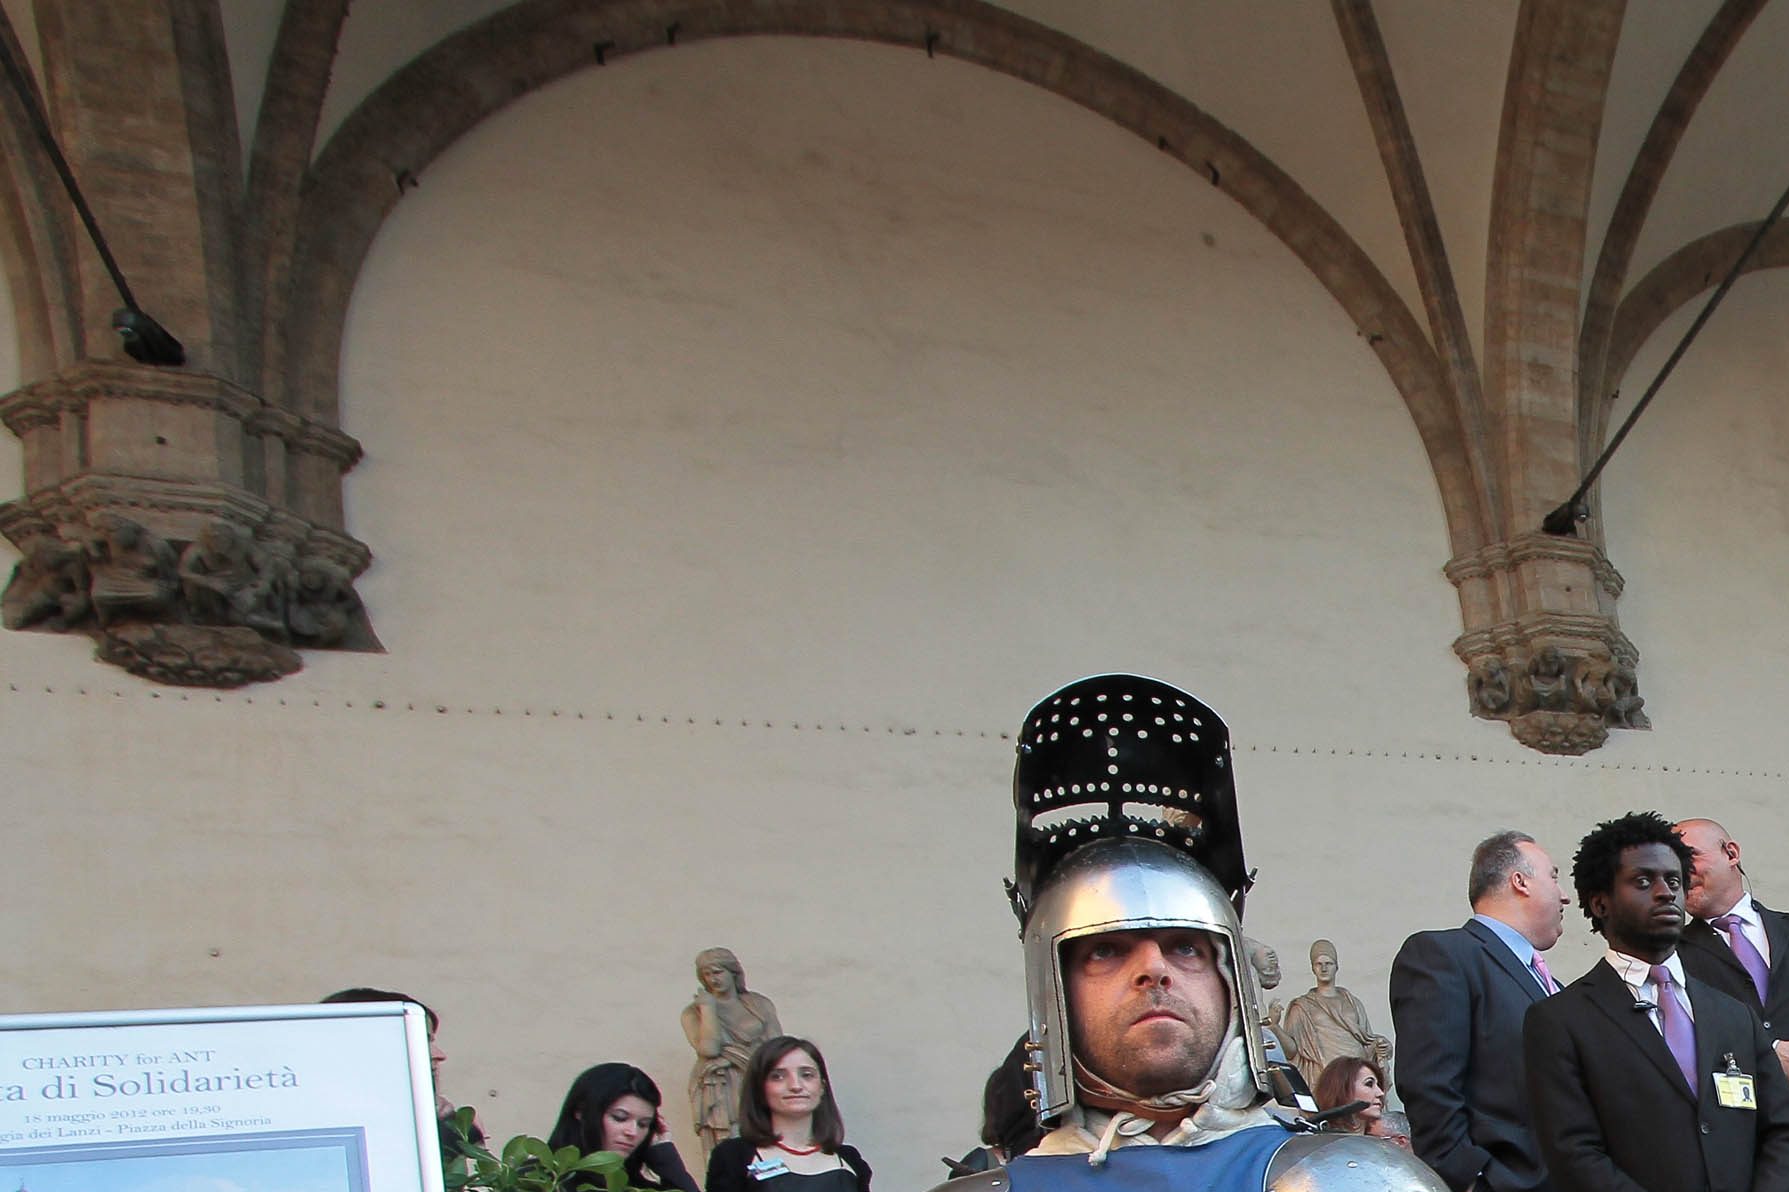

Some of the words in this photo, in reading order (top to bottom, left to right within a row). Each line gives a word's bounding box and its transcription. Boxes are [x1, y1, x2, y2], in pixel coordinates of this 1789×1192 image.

[22, 1054, 128, 1070] CHARITY
[136, 1053, 162, 1065] for
[168, 1050, 216, 1063] ANT
[41, 1075, 80, 1100] di
[93, 1066, 298, 1097] Solidarietà
[25, 1114, 42, 1123] 18
[47, 1111, 106, 1124] maggio
[110, 1109, 147, 1119] 2012
[152, 1108, 176, 1116] ore
[28, 1128, 52, 1139] dei
[58, 1127, 101, 1138] Lanzi
[118, 1124, 166, 1134] Piazza
[171, 1120, 206, 1130] della
[210, 1117, 272, 1129] Signoria
